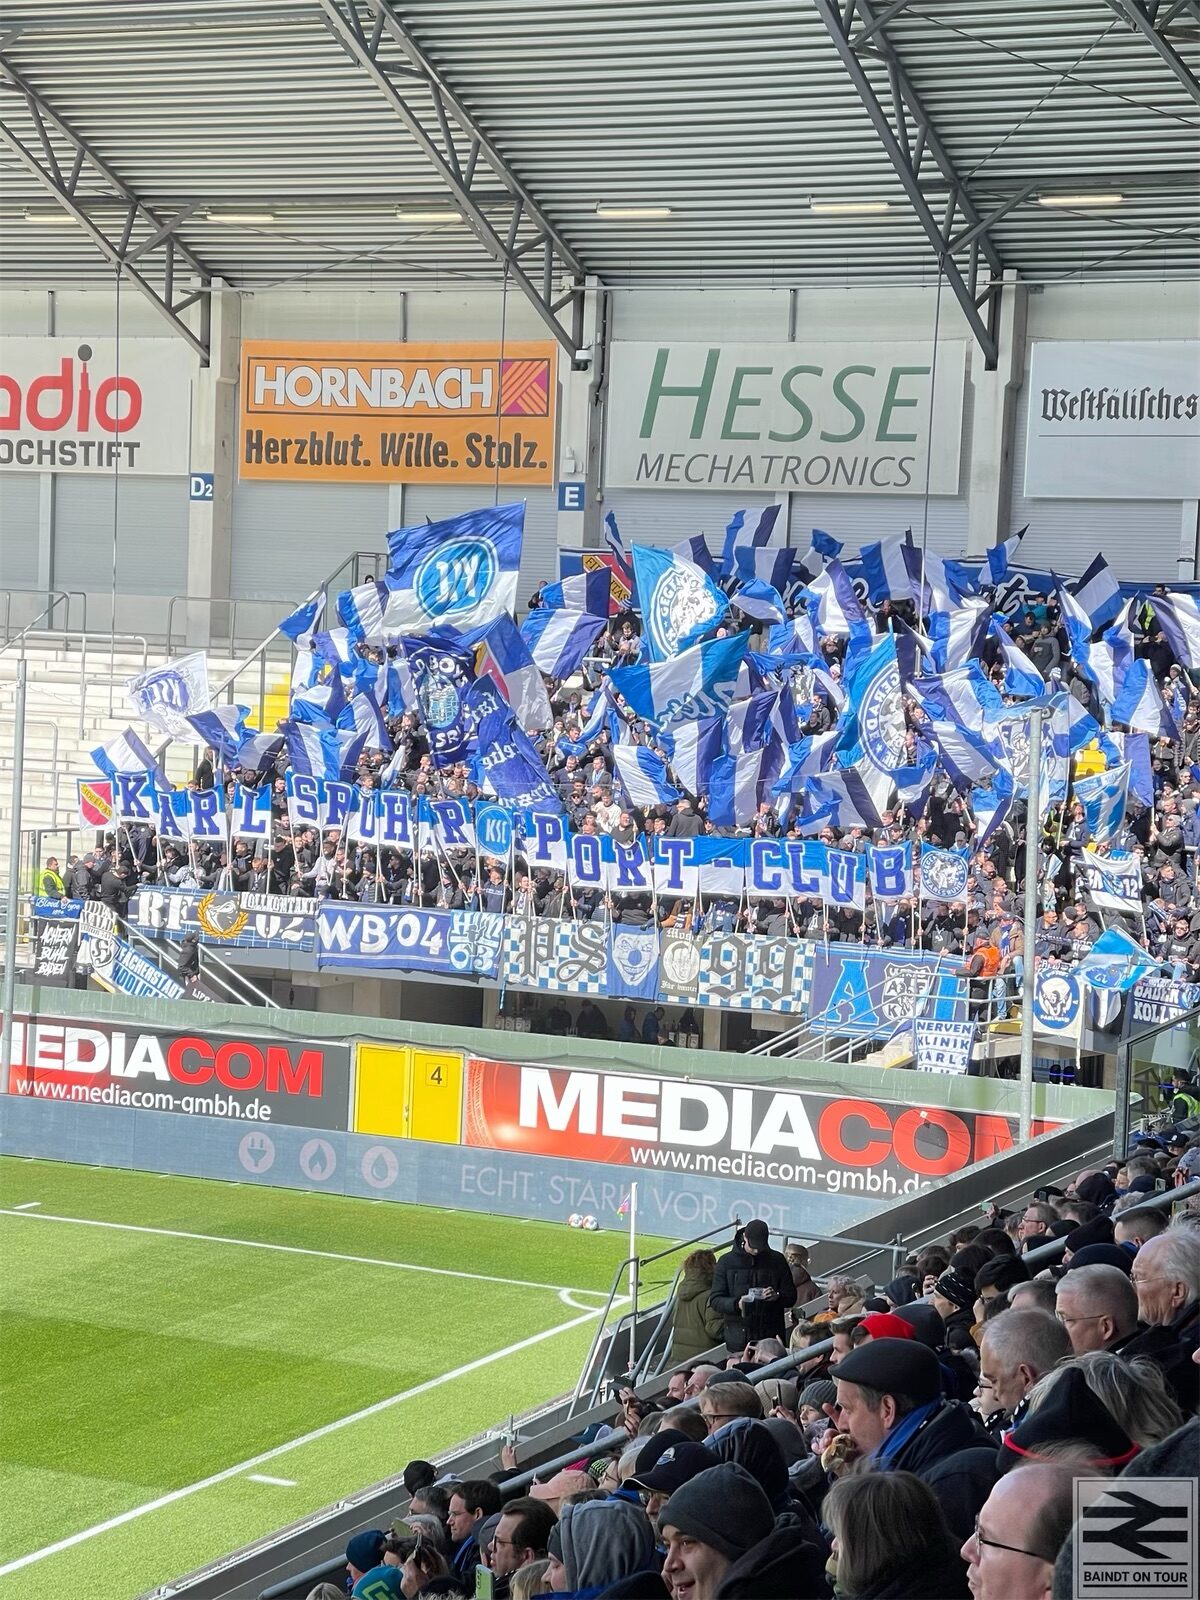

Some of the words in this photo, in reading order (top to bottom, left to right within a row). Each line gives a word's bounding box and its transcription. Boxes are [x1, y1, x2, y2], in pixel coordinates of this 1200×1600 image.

[253, 365, 494, 409] HORNBACH
[639, 348, 931, 443] HESSE
[245, 429, 371, 467] Herzblut.
[381, 431, 459, 468] Wille.
[466, 431, 548, 470] Stolz.
[191, 477, 213, 498] D2
[635, 452, 916, 488] MECHATRONICS
[565, 486, 580, 507] E
[585, 557, 630, 602] FIITAS
[486, 818, 507, 843] KSC
[40, 922, 77, 946] ACHERN
[316, 907, 443, 955] WB'04
[34, 960, 68, 977] BADEN
[36, 945, 69, 962] BÜHL
[110, 963, 167, 998] HOOLIG
[118, 946, 186, 999] FÄCHERSTADT
[820, 959, 879, 1026] A
[917, 1022, 973, 1034] NERVEN
[917, 1035, 970, 1050] KLINIK
[430, 1067, 443, 1085] 4
[917, 1052, 969, 1068] KARLS
[16, 1079, 272, 1122] www.mediacom-gmbh.de
[461, 1165, 535, 1201] ECHT.
[653, 1188, 718, 1223] VOR
